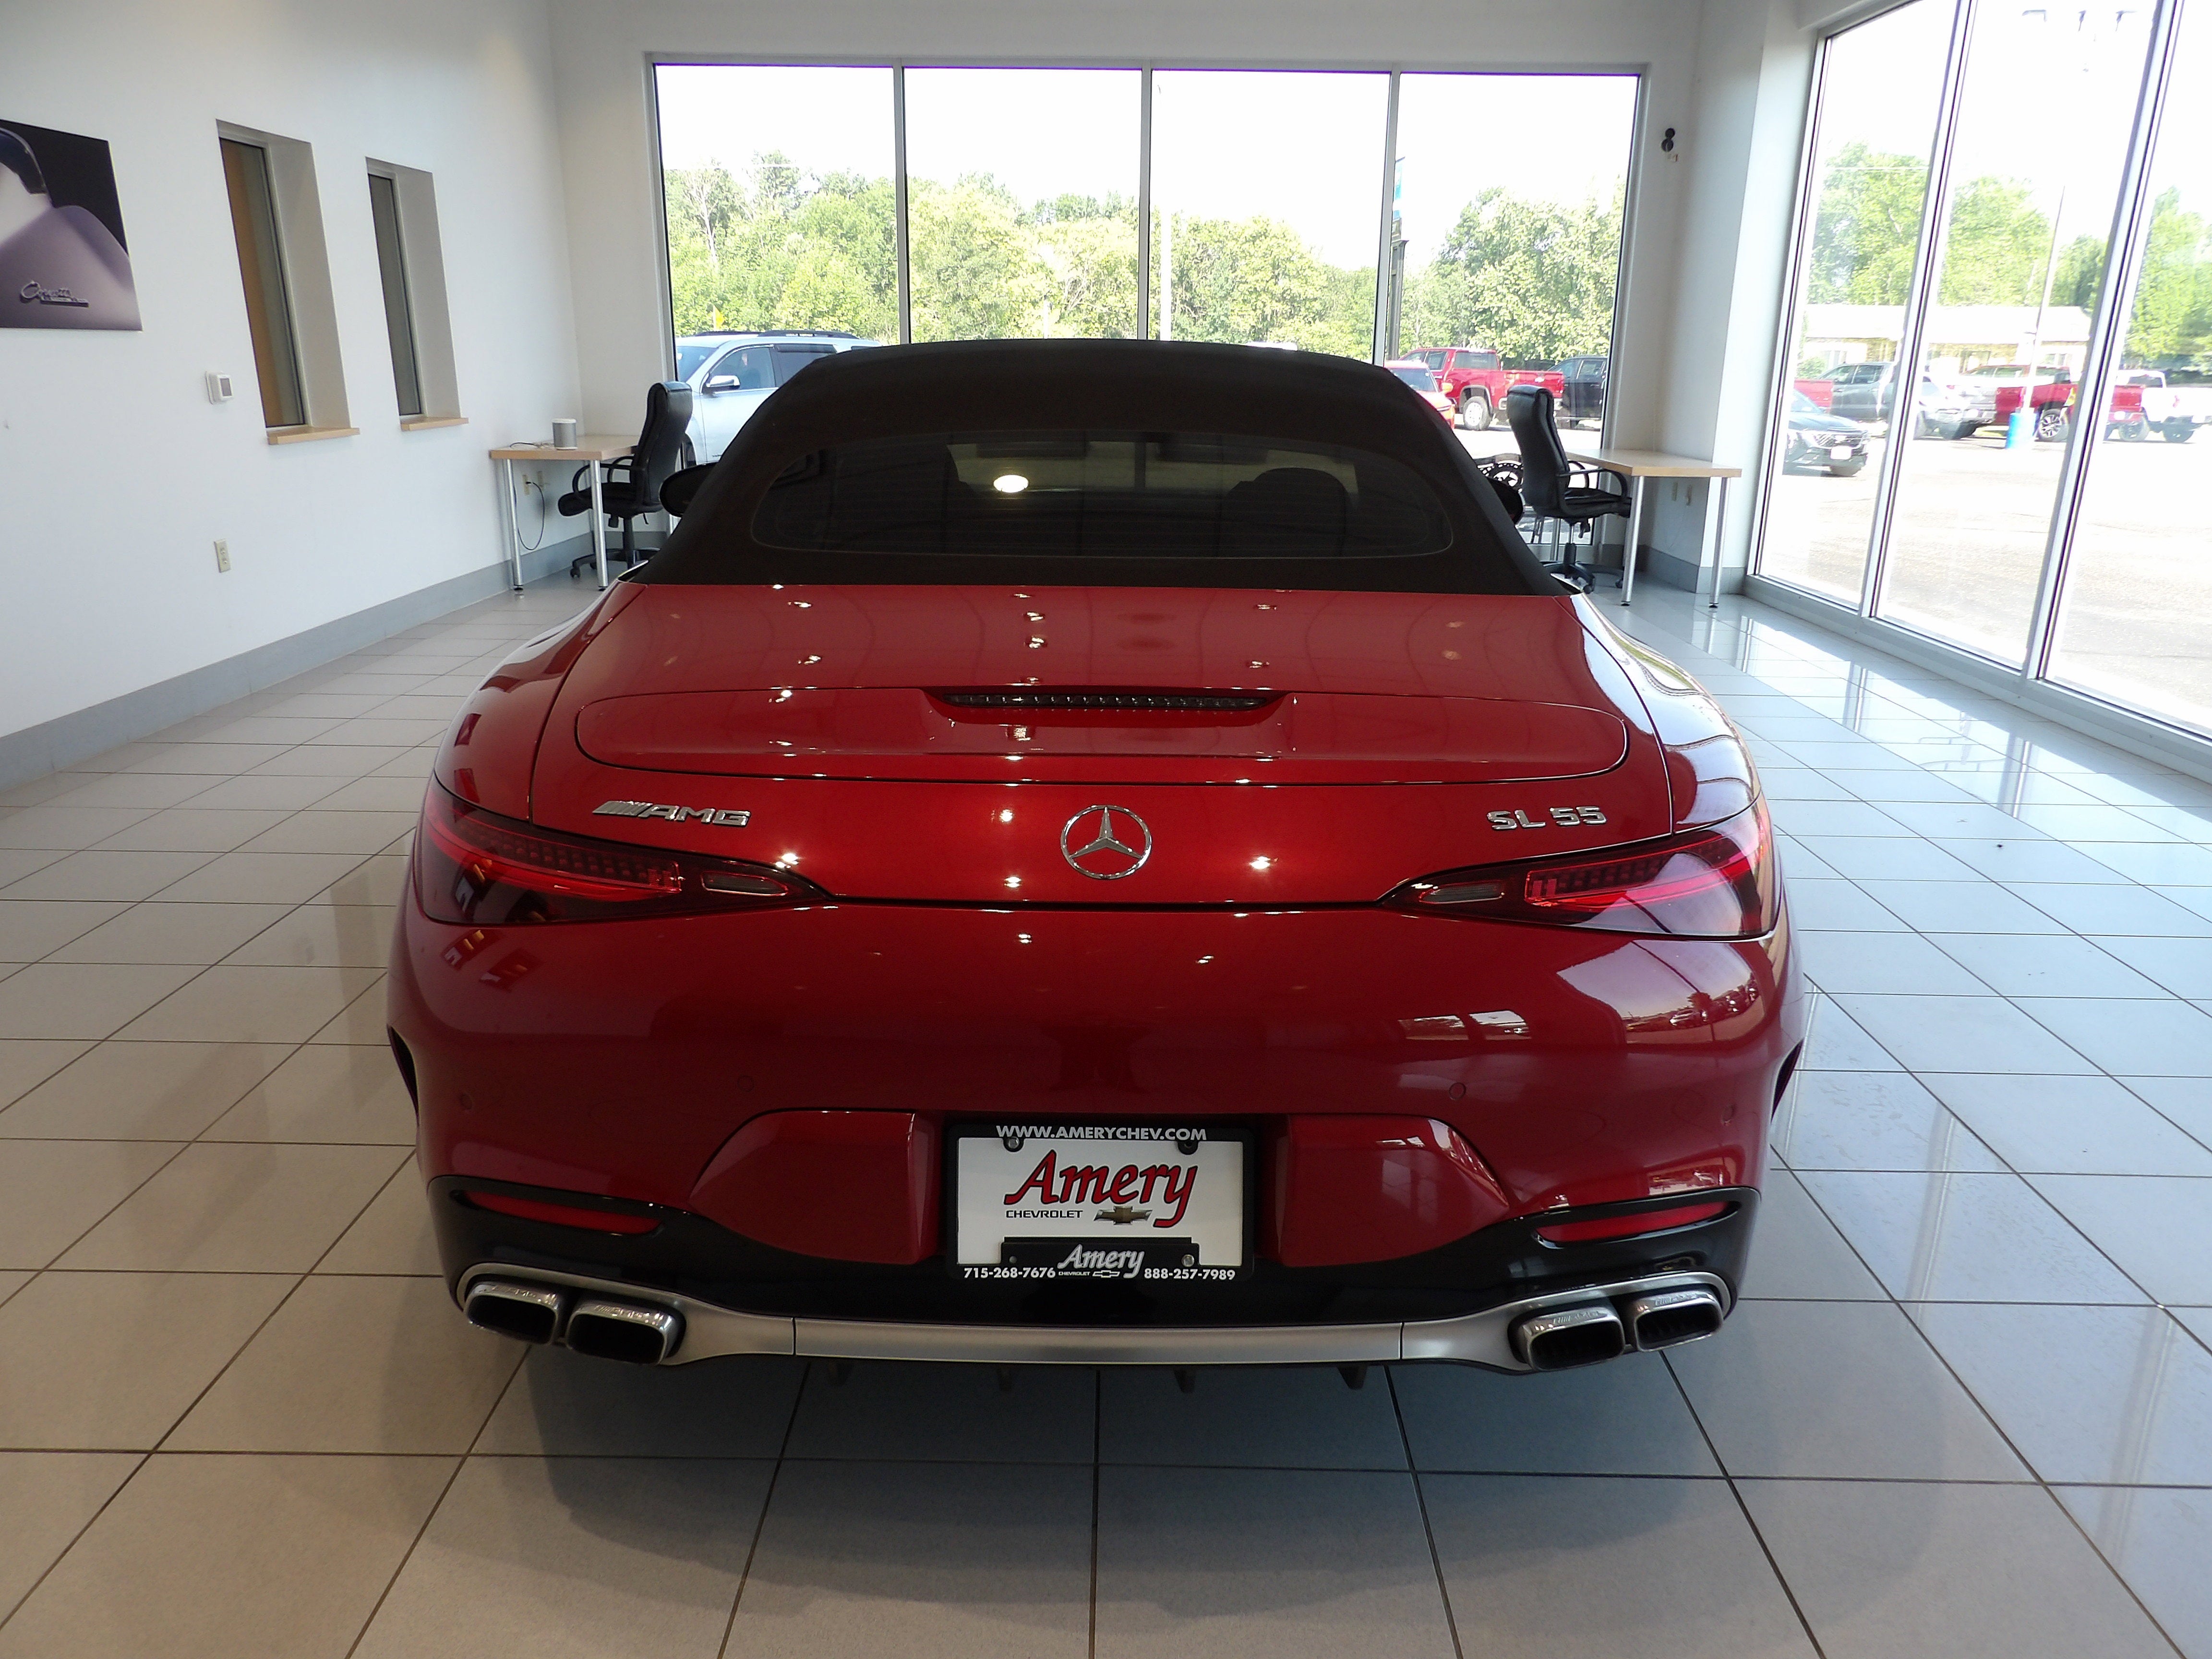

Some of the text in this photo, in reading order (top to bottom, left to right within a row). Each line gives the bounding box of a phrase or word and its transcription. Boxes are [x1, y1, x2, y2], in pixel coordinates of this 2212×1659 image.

[637, 804, 751, 826] AMG
[1487, 806, 1607, 830] SL 55
[996, 1125, 1207, 1141] WWW.AMERYCHEV.COM
[1004, 1149, 1198, 1228] Amery
[1006, 1210, 1083, 1218] CHEVROLET
[1057, 1244, 1145, 1278] Amery
[964, 1267, 1056, 1278] 715-268-7676
[1144, 1268, 1236, 1280] 888-257-7989
